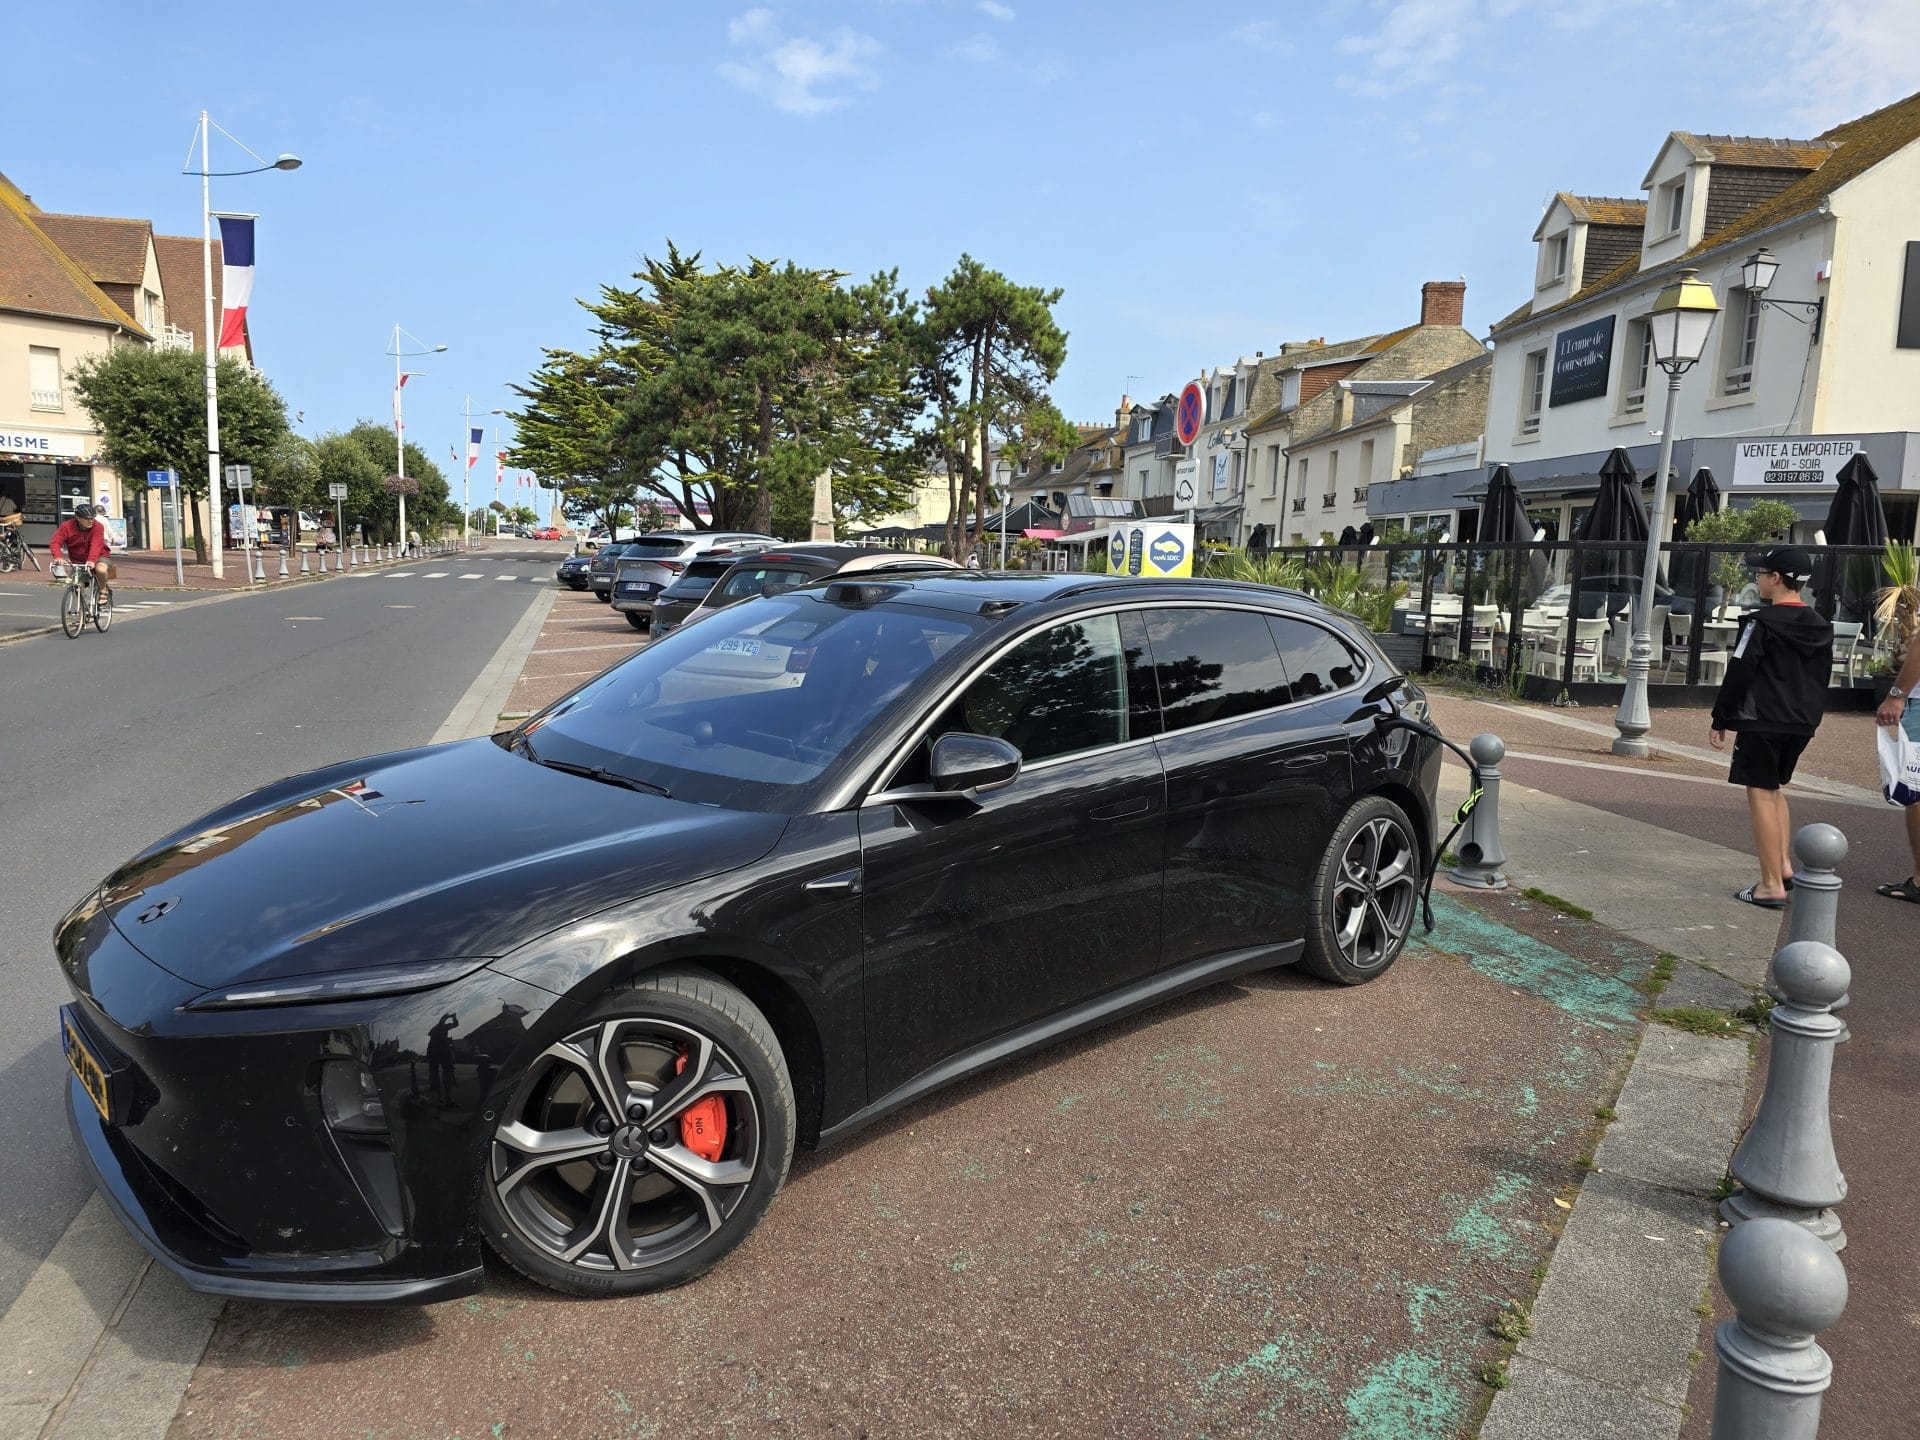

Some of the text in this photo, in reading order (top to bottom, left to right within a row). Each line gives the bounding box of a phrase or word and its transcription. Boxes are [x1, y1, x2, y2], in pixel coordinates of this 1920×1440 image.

[1593, 330, 1604, 346] de
[1557, 350, 1604, 374] Courseulles
[1743, 442, 1854, 458] VENTE A EMPORTER
[1770, 458, 1790, 470] MIDI
[1799, 458, 1821, 470] SOIR
[1765, 472, 1823, 482] 02 31 97 06 34
[695, 1117, 704, 1135] NIO
